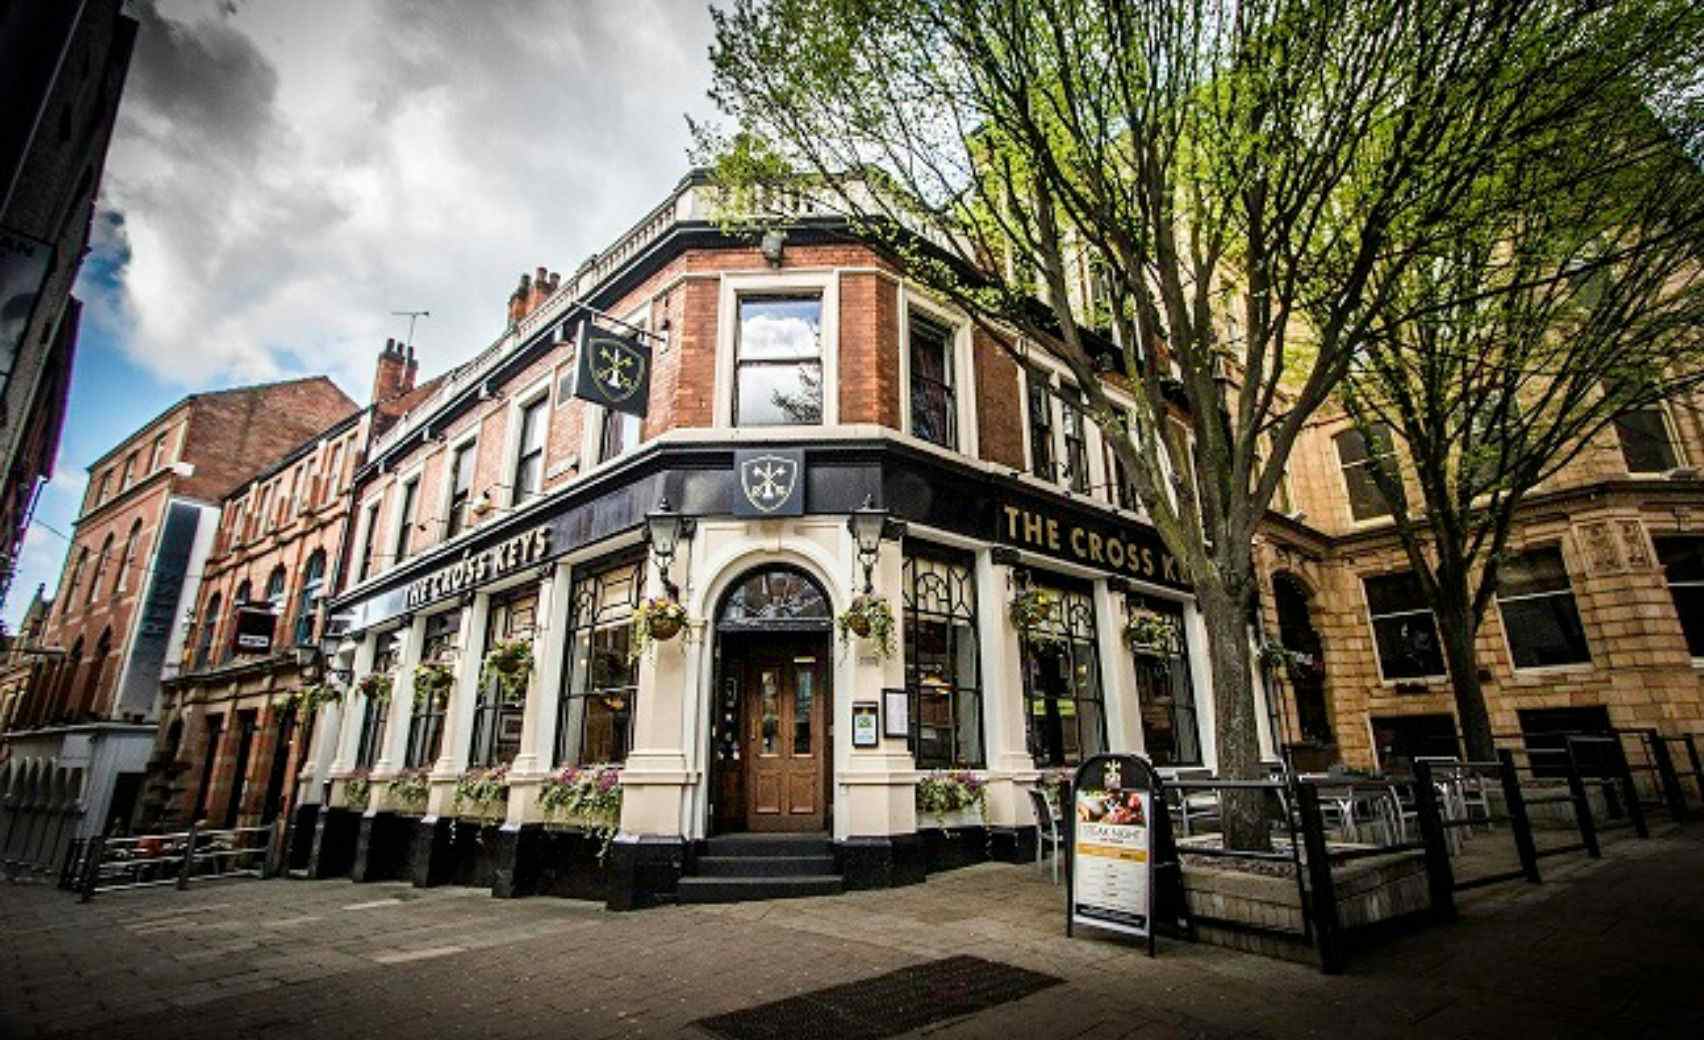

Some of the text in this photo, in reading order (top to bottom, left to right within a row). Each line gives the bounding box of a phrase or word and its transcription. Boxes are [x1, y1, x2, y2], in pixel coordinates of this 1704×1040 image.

[402, 527, 552, 608] THE CROSS KEYS
[1004, 505, 1060, 550] THE
[1070, 527, 1155, 577] CROSS
